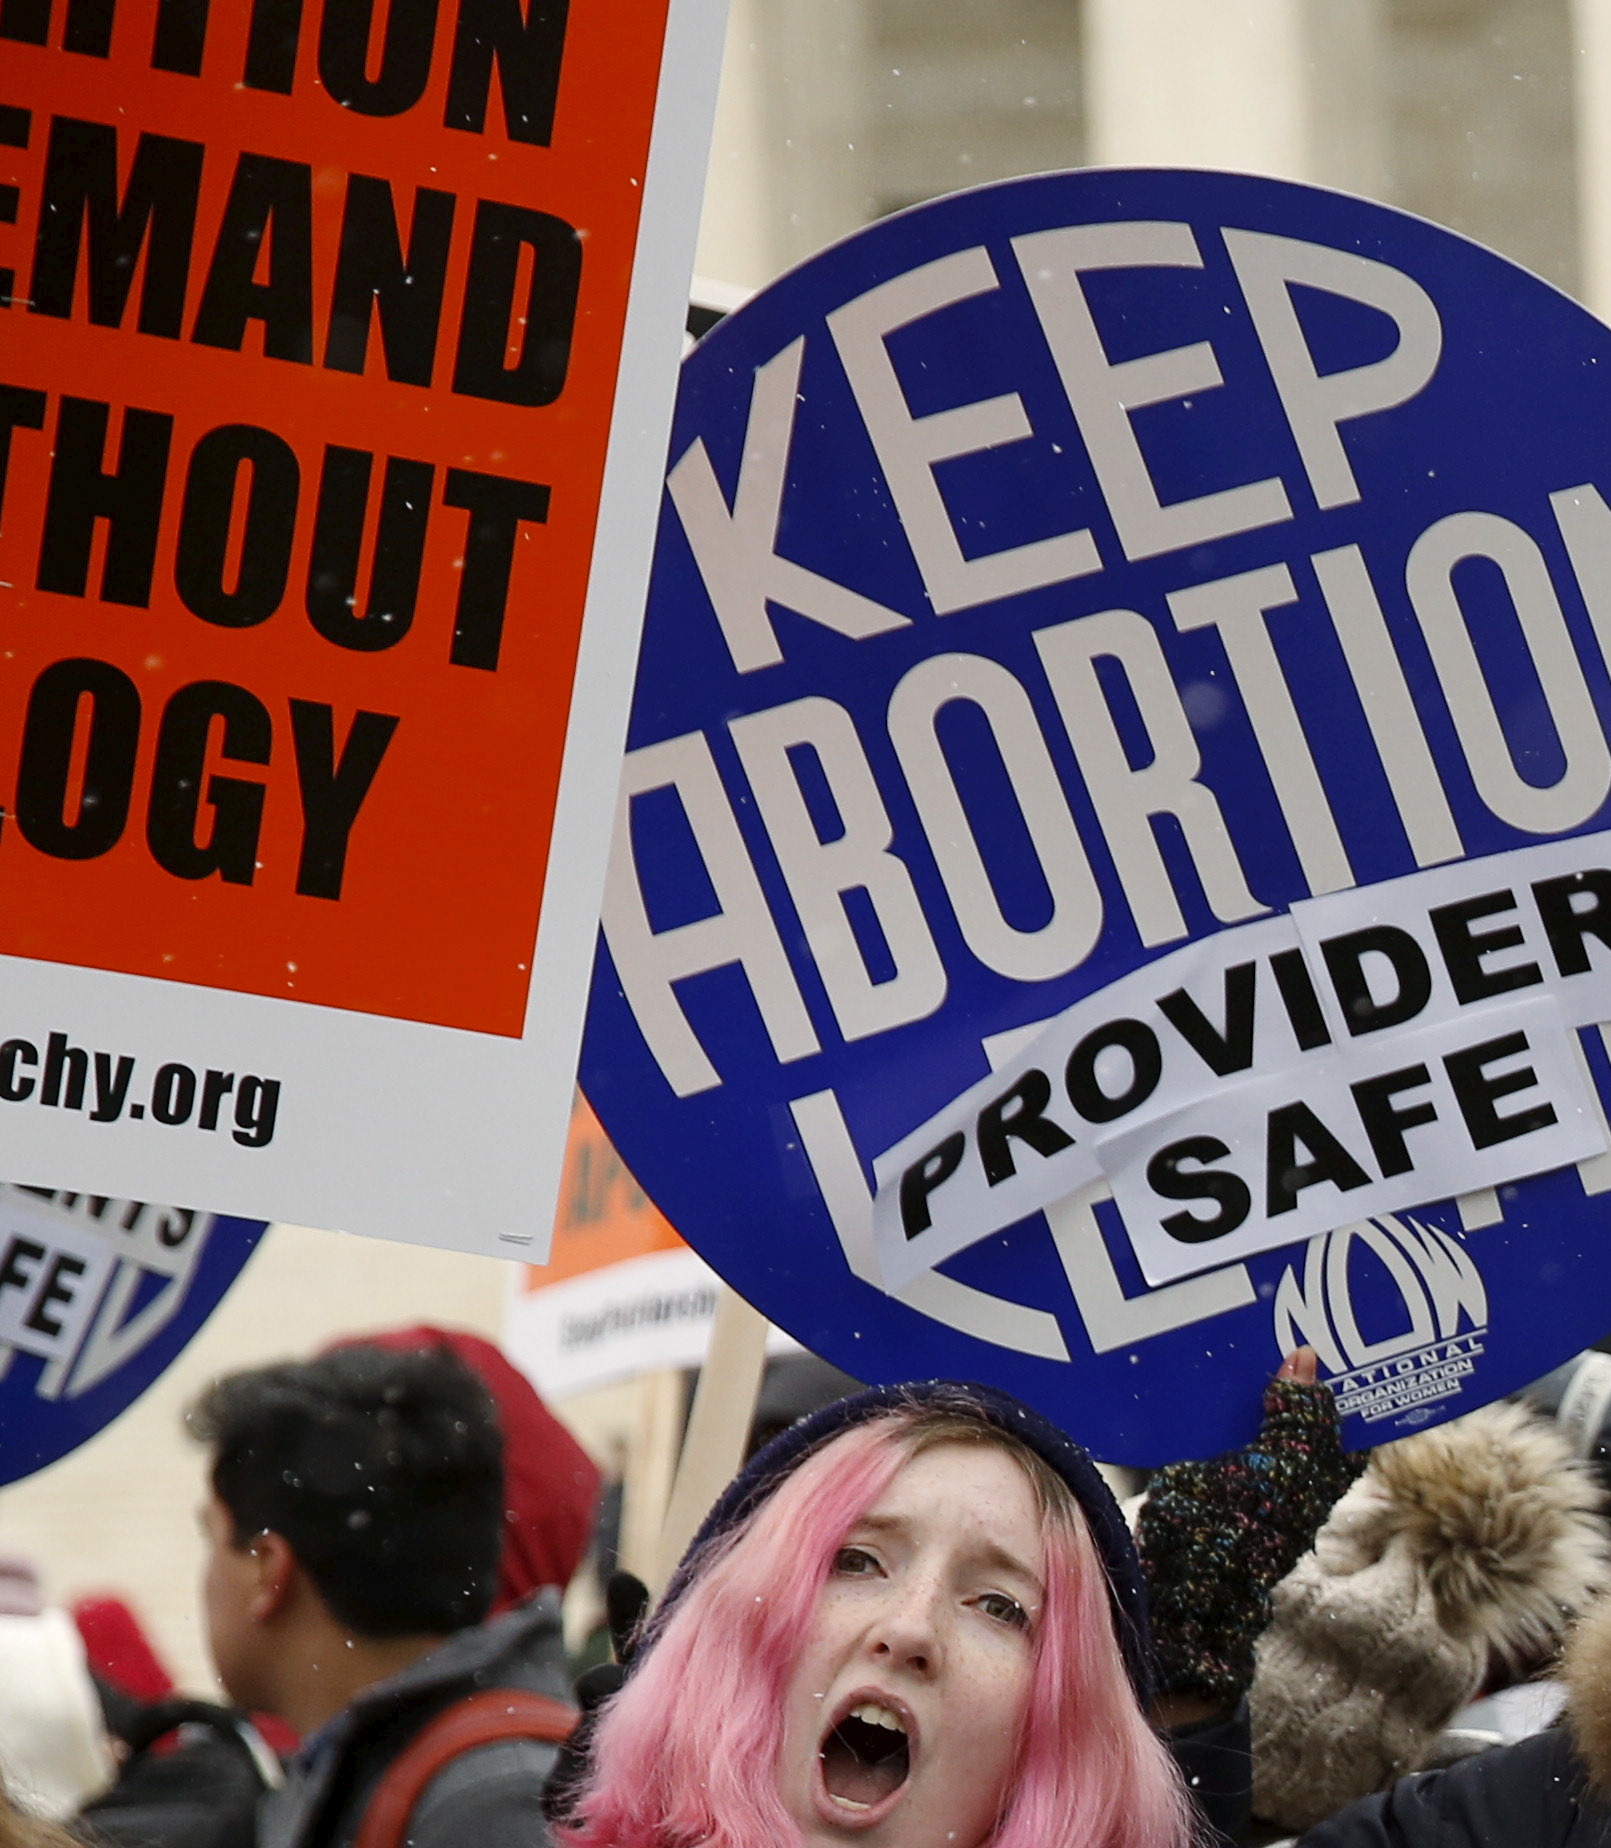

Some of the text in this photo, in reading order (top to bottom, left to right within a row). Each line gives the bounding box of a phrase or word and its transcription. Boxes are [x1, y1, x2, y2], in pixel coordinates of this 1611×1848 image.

[666, 220, 1442, 674] KEEP
[1145, 1031, 1558, 1245] SAFE
[1274, 1212, 1488, 1375] NOW
[1329, 1337, 1483, 1394] ATIONAL
[1336, 1358, 1474, 1411] ORGANIZATION
[1361, 1398, 1395, 1418] FOR
[1395, 1378, 1462, 1407] WOMEN
